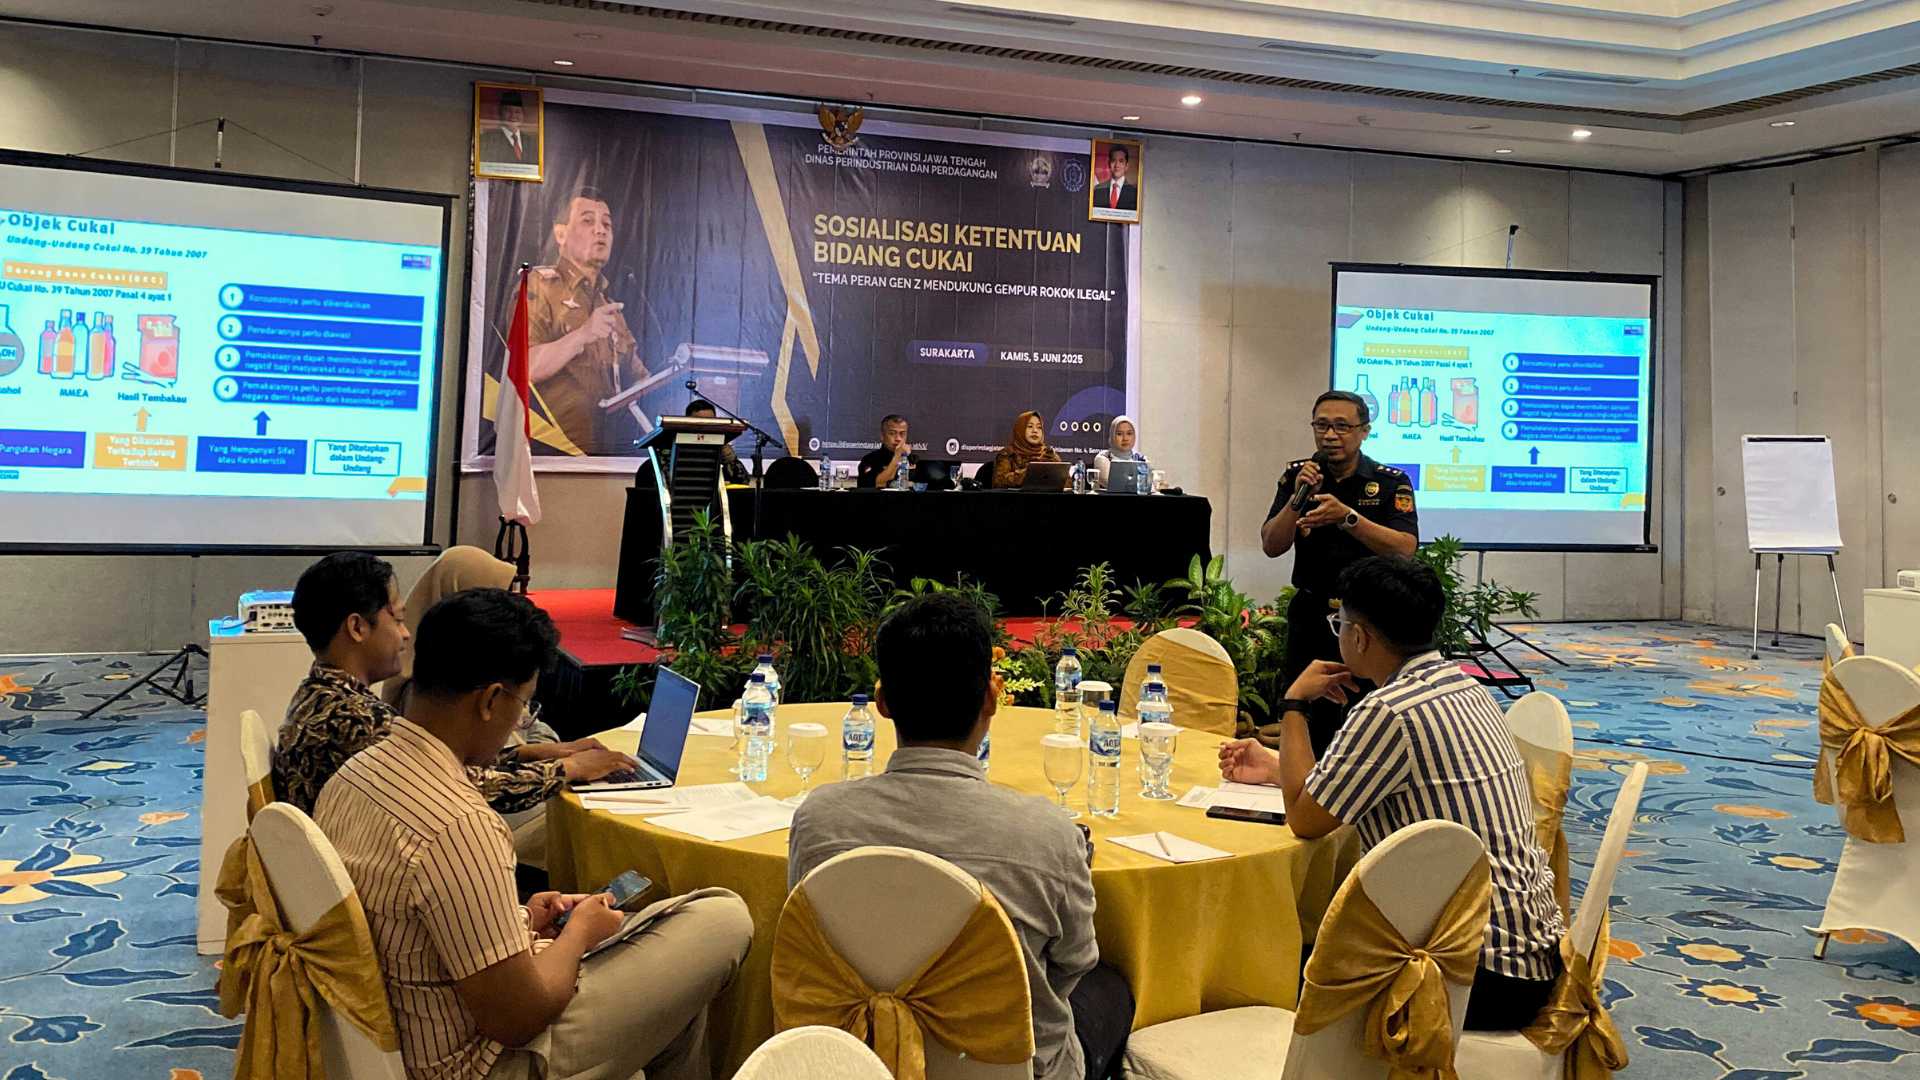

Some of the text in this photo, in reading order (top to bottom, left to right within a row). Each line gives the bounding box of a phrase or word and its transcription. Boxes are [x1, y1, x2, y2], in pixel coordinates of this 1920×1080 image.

[879, 149, 922, 162] PROVINSI
[923, 153, 948, 164] JAWA
[951, 155, 986, 167] TENGAH
[805, 154, 998, 180] DINAS PERINDUSTRIAN DAN PERDAGANGAN
[8, 214, 115, 235] Objek Cukai
[813, 213, 1081, 254] SOSIALISASI KETENTUAN
[140, 246, 152, 255] 39
[185, 249, 208, 259] 2007
[813, 241, 973, 273] BIDANG CUKAI
[51, 286, 62, 294] 39
[64, 286, 90, 296] Tahun
[93, 288, 113, 297] 2007
[141, 291, 146, 299] 4
[850, 273, 887, 288] PERAN
[888, 276, 912, 289] GEN
[913, 278, 921, 289] Z
[923, 279, 993, 294] MENDUKUNG
[994, 283, 1038, 297] GEMPUR
[1039, 286, 1075, 299] ROKOK
[1367, 309, 1434, 321] Objek Cukai
[920, 347, 975, 360] SURAKARTA
[1000, 351, 1083, 364] KAMIS, 5 JUNI 2025
[60, 389, 89, 398] MMEA
[118, 393, 139, 402] Hasil
[328, 443, 389, 455] Yang Ditetapkan
[330, 454, 353, 462] dalam
[343, 464, 371, 474] Undang
